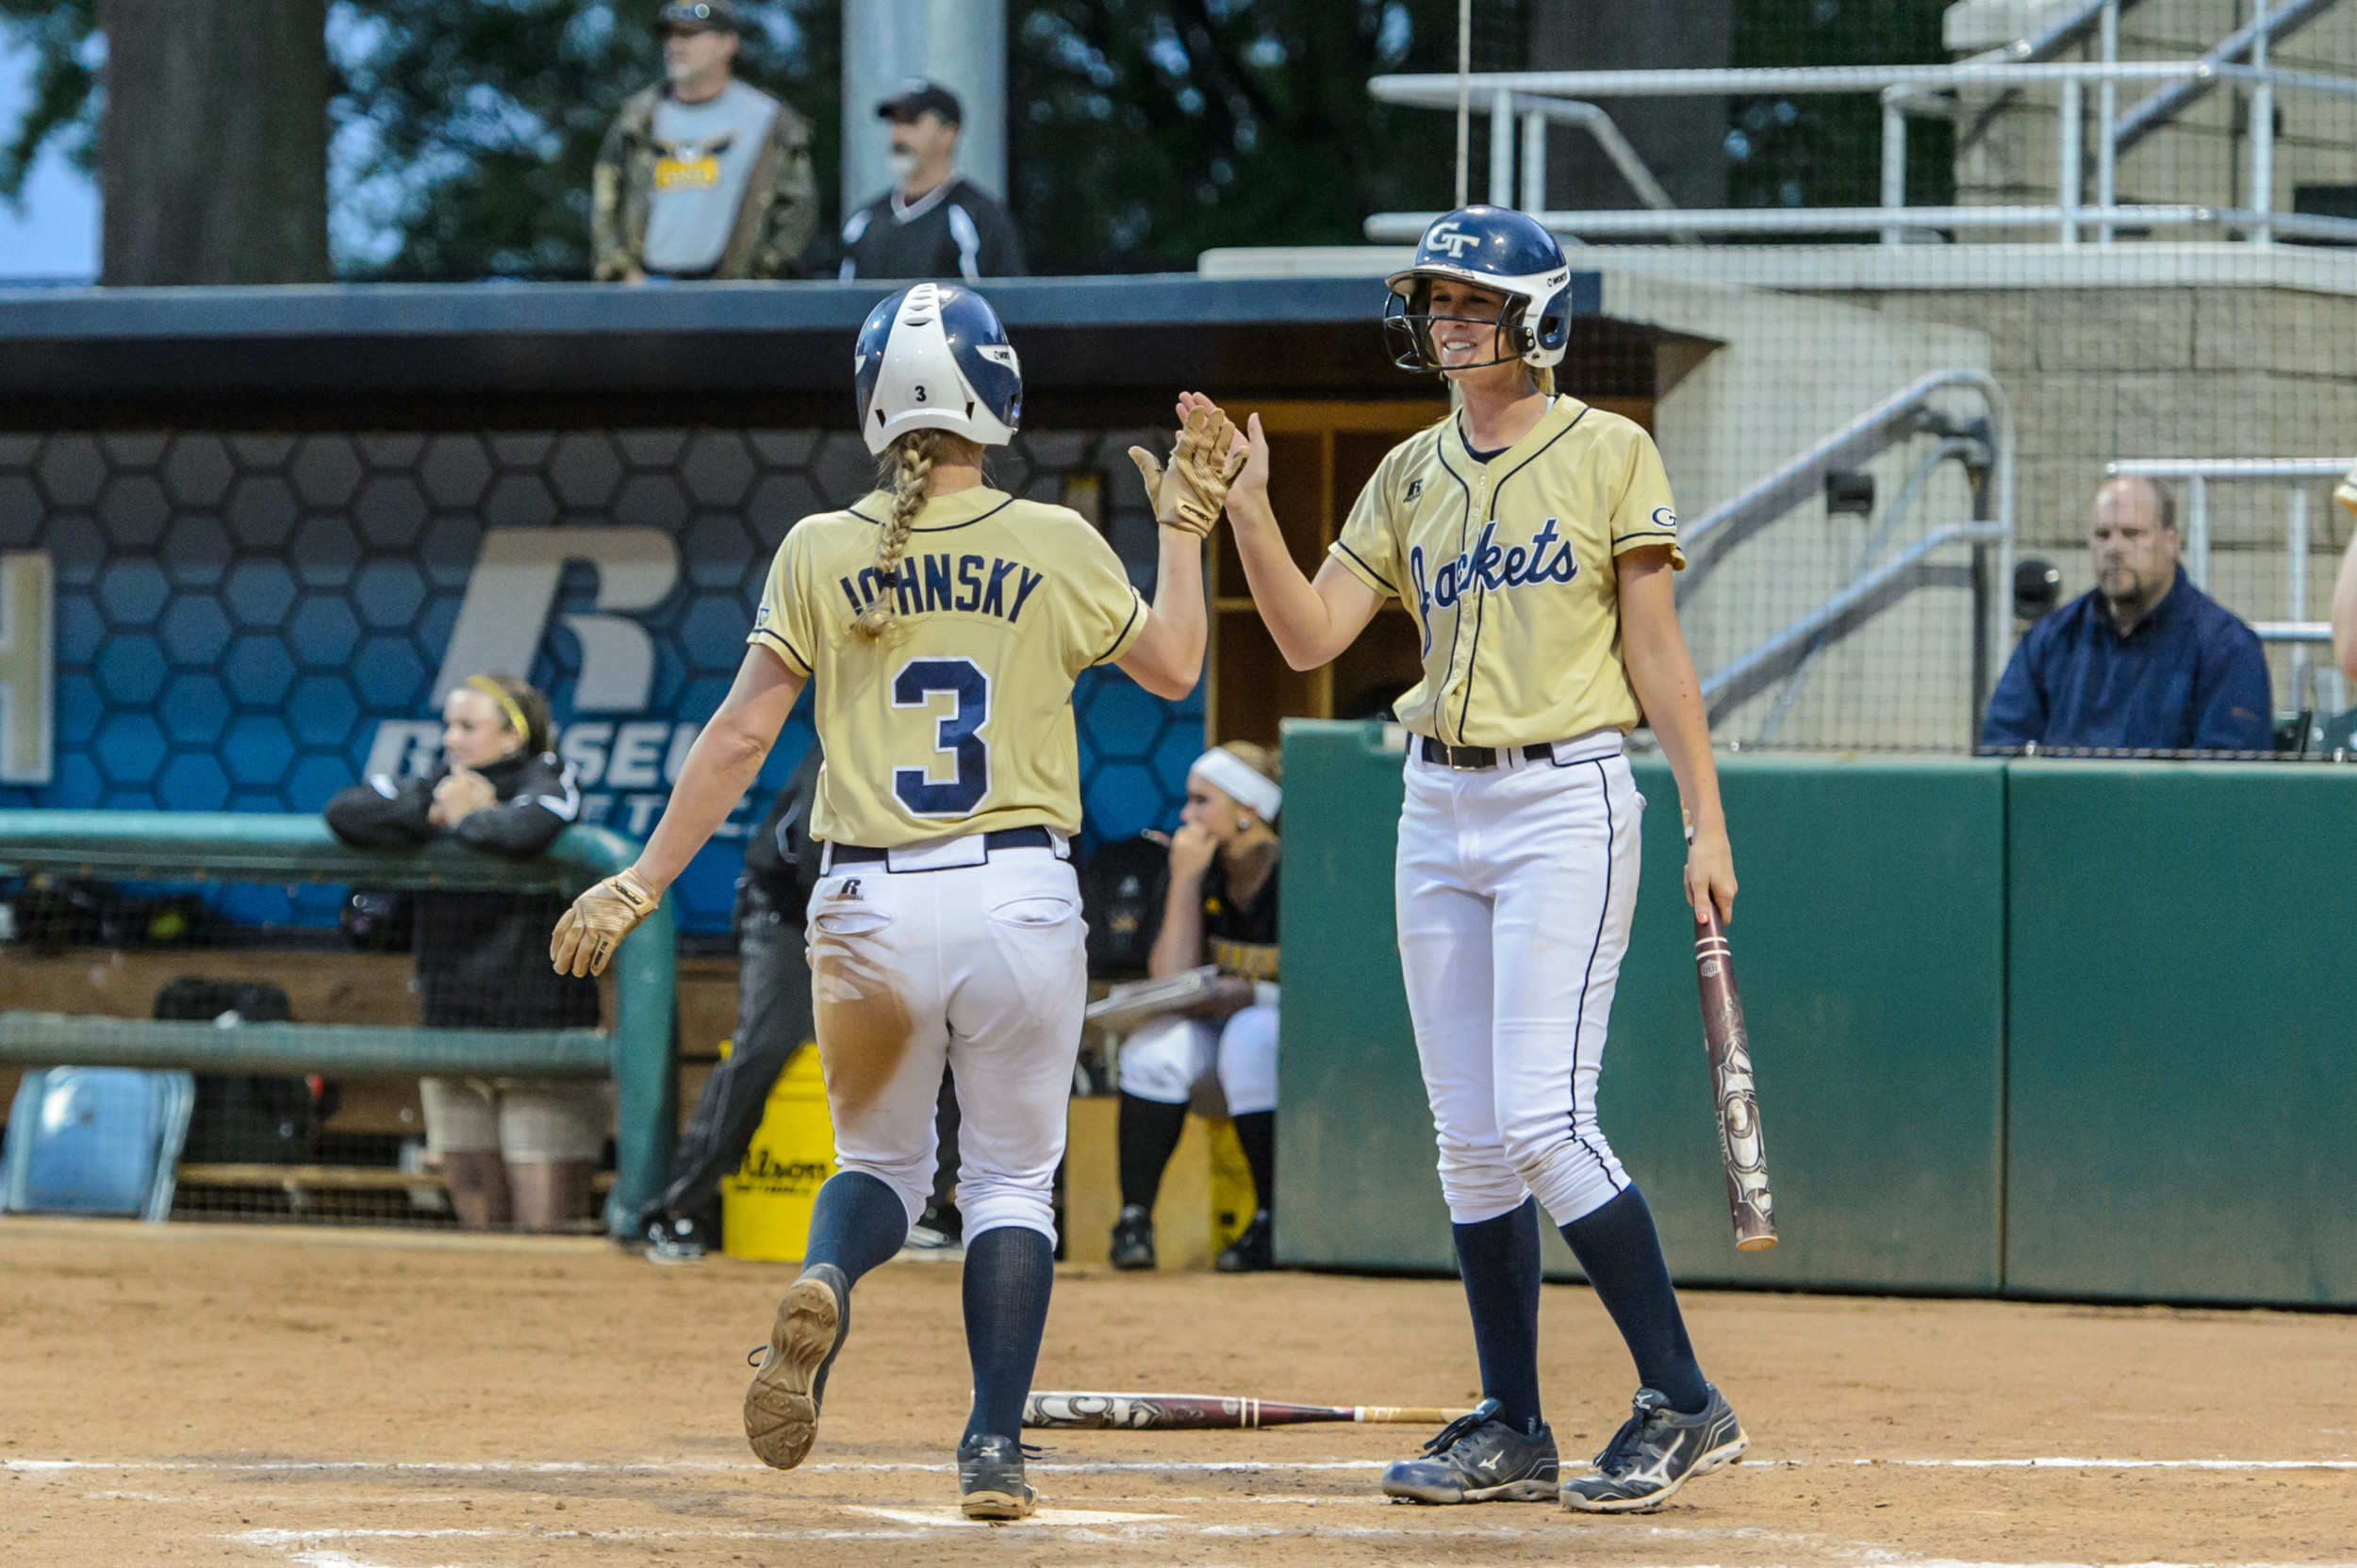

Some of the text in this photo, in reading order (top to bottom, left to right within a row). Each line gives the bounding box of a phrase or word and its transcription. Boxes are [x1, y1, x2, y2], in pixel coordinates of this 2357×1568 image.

[1426, 222, 1480, 258] GT
[915, 385, 927, 403] 3
[840, 553, 1044, 630] JOHNSKY
[1410, 518, 1579, 660] Jackets
[890, 656, 992, 818] 3
